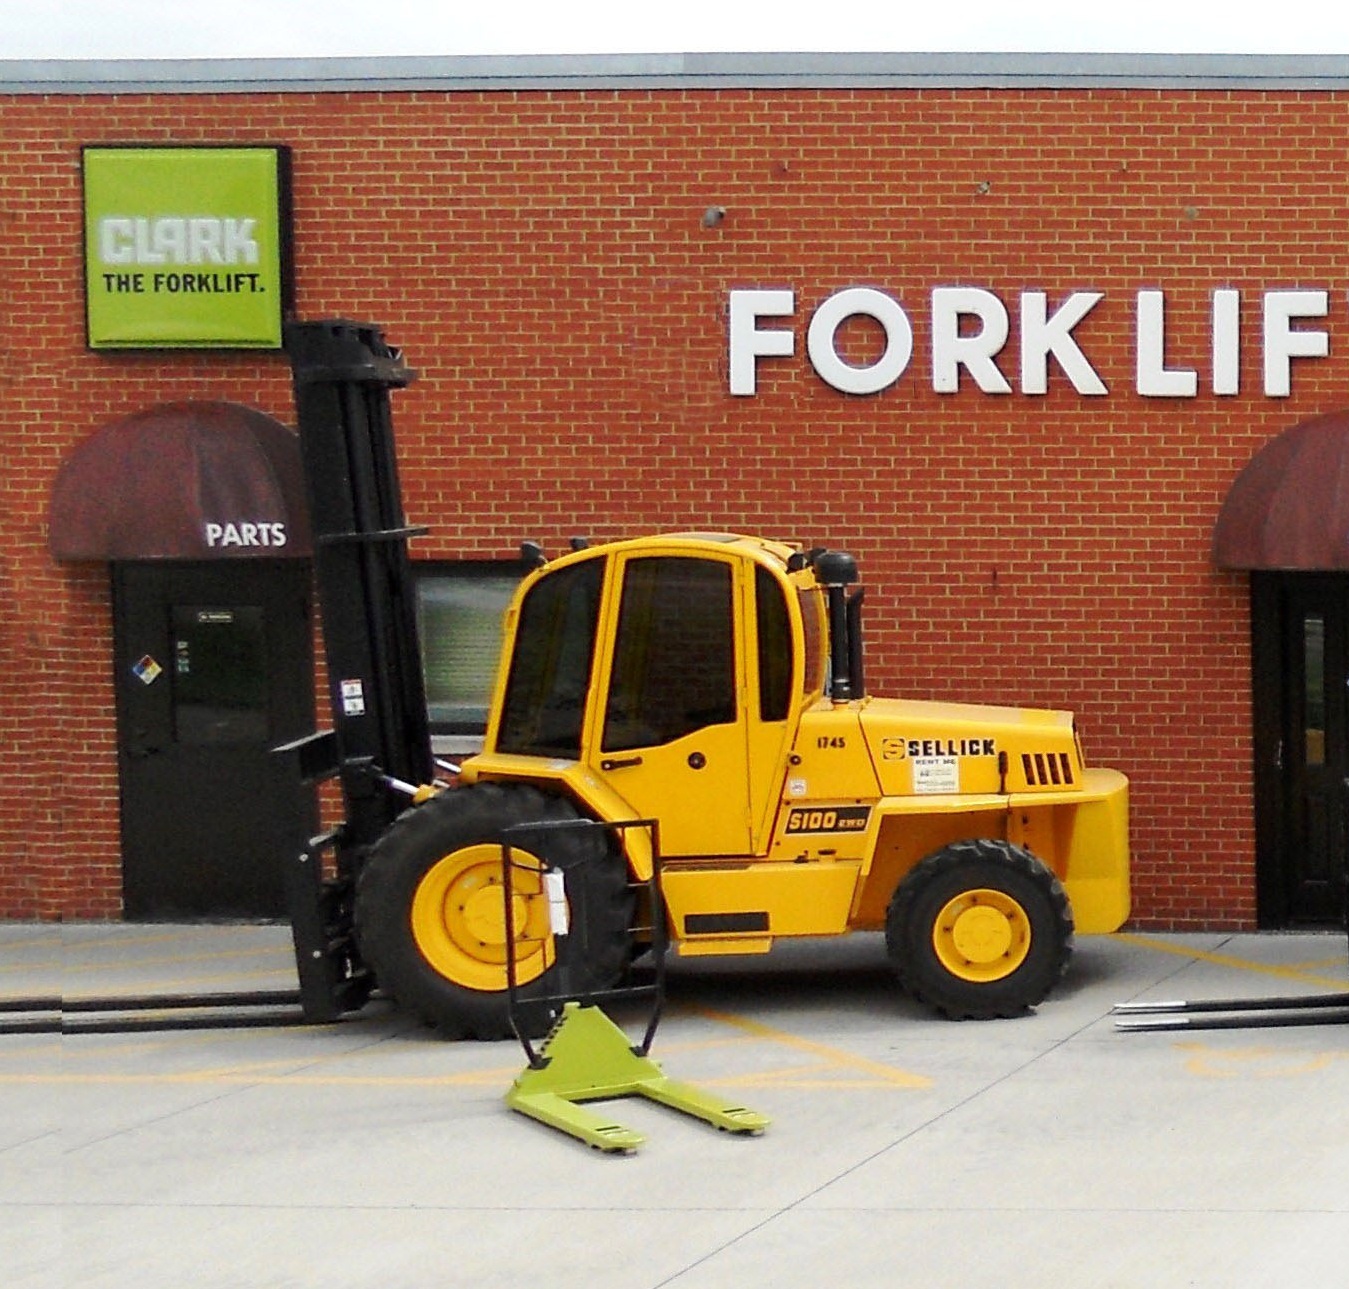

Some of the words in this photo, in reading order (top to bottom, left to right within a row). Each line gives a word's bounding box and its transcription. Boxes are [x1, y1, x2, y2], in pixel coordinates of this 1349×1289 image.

[98, 216, 260, 264] CLARK
[102, 273, 145, 292] THE
[153, 273, 265, 292] FORKLIFT.
[206, 522, 287, 547] PARTS
[817, 736, 846, 749] 1745
[908, 739, 995, 756] SELLICK
[789, 811, 837, 830] S100
